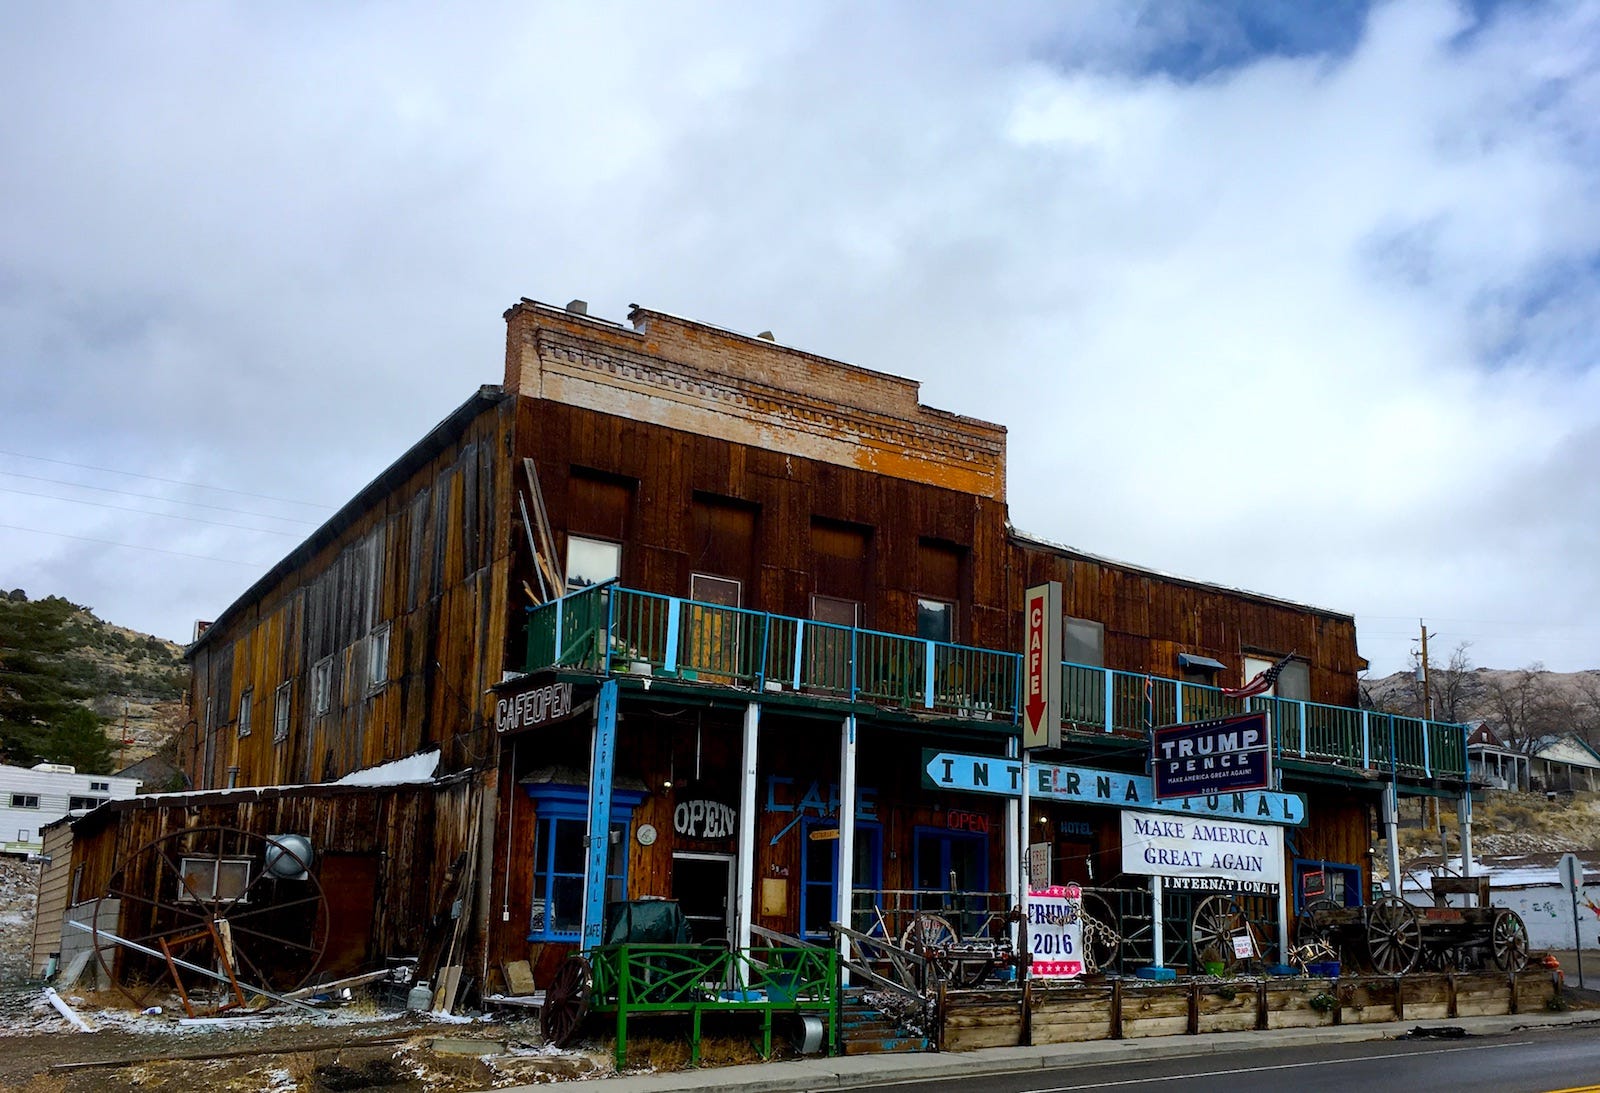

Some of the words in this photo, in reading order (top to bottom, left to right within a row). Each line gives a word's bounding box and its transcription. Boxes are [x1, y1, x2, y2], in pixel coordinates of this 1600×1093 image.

[1031, 608, 1041, 695] CAFE
[1162, 730, 1258, 759] TRUMP
[1170, 754, 1248, 773] PENCE
[941, 758, 1294, 819] INTERNAIONAL
[1168, 776, 1183, 784] MAKE
[1184, 773, 1209, 781] AMERICA
[1210, 771, 1229, 779] GREAT
[592, 681, 611, 902] INTERNATIONAL
[674, 800, 736, 838] OPEN
[949, 810, 989, 833] OPEN
[1060, 820, 1093, 836] HOTEL
[1134, 818, 1185, 838] MAKE
[1192, 825, 1269, 846] AMERICA
[1033, 850, 1046, 862] FREE
[1144, 846, 1203, 867] GREAT
[1210, 853, 1263, 872] AGAIN
[1033, 863, 1046, 876] REST
[1164, 876, 1278, 894] INTERNATIONAL
[585, 923, 601, 938] CAFE
[1034, 933, 1073, 955] 2016
